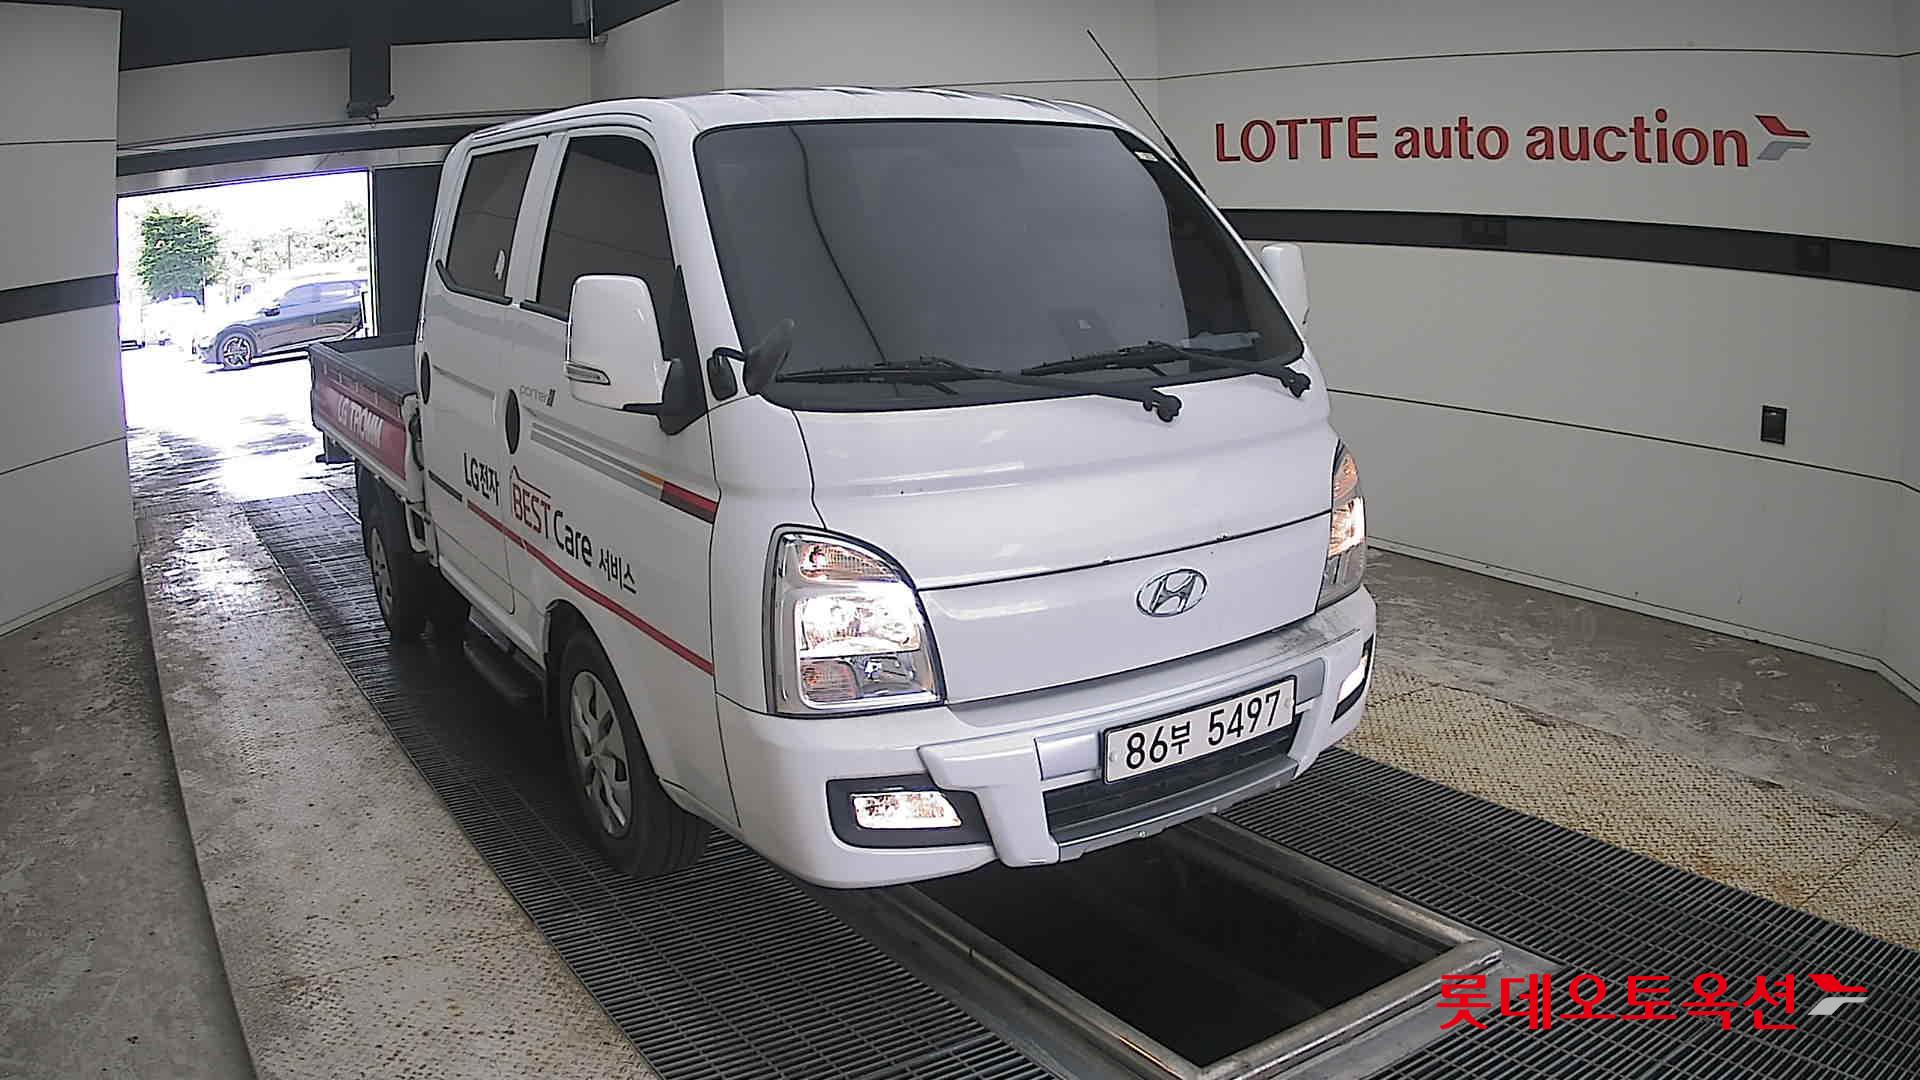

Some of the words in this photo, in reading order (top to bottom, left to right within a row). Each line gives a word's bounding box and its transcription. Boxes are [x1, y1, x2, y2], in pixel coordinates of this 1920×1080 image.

[1215, 115, 1378, 163] LOTTE
[1394, 115, 1510, 160] auto
[1525, 108, 1749, 167] auction
[463, 452, 499, 506] LG전자
[512, 482, 551, 539] BEST
[553, 510, 593, 568] Care
[599, 547, 637, 594] 서비스
[1126, 720, 1191, 769] 86부
[1207, 689, 1281, 746] 5497
